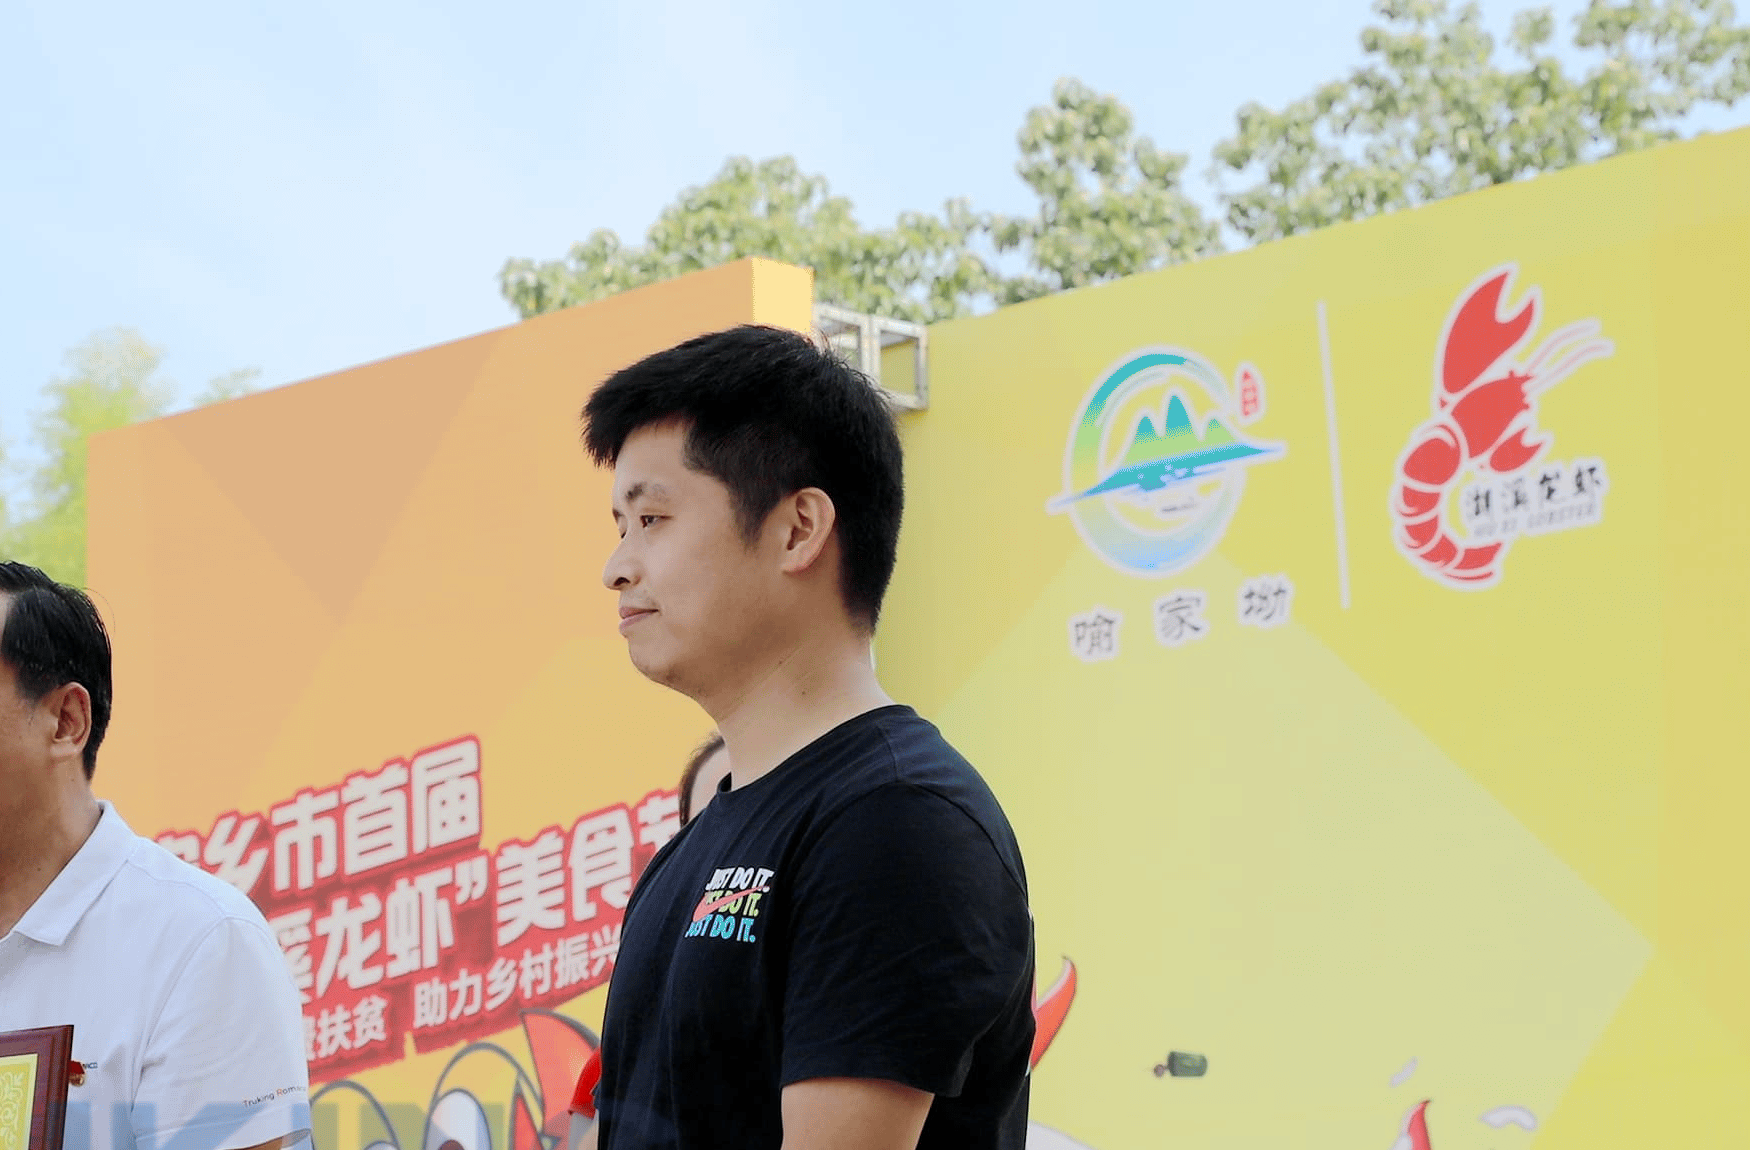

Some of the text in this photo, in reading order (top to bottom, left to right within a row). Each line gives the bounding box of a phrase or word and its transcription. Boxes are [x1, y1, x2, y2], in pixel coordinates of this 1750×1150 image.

[1074, 583, 1287, 656] 喻家坳
[729, 866, 755, 890] DO
[709, 914, 736, 939] DO
